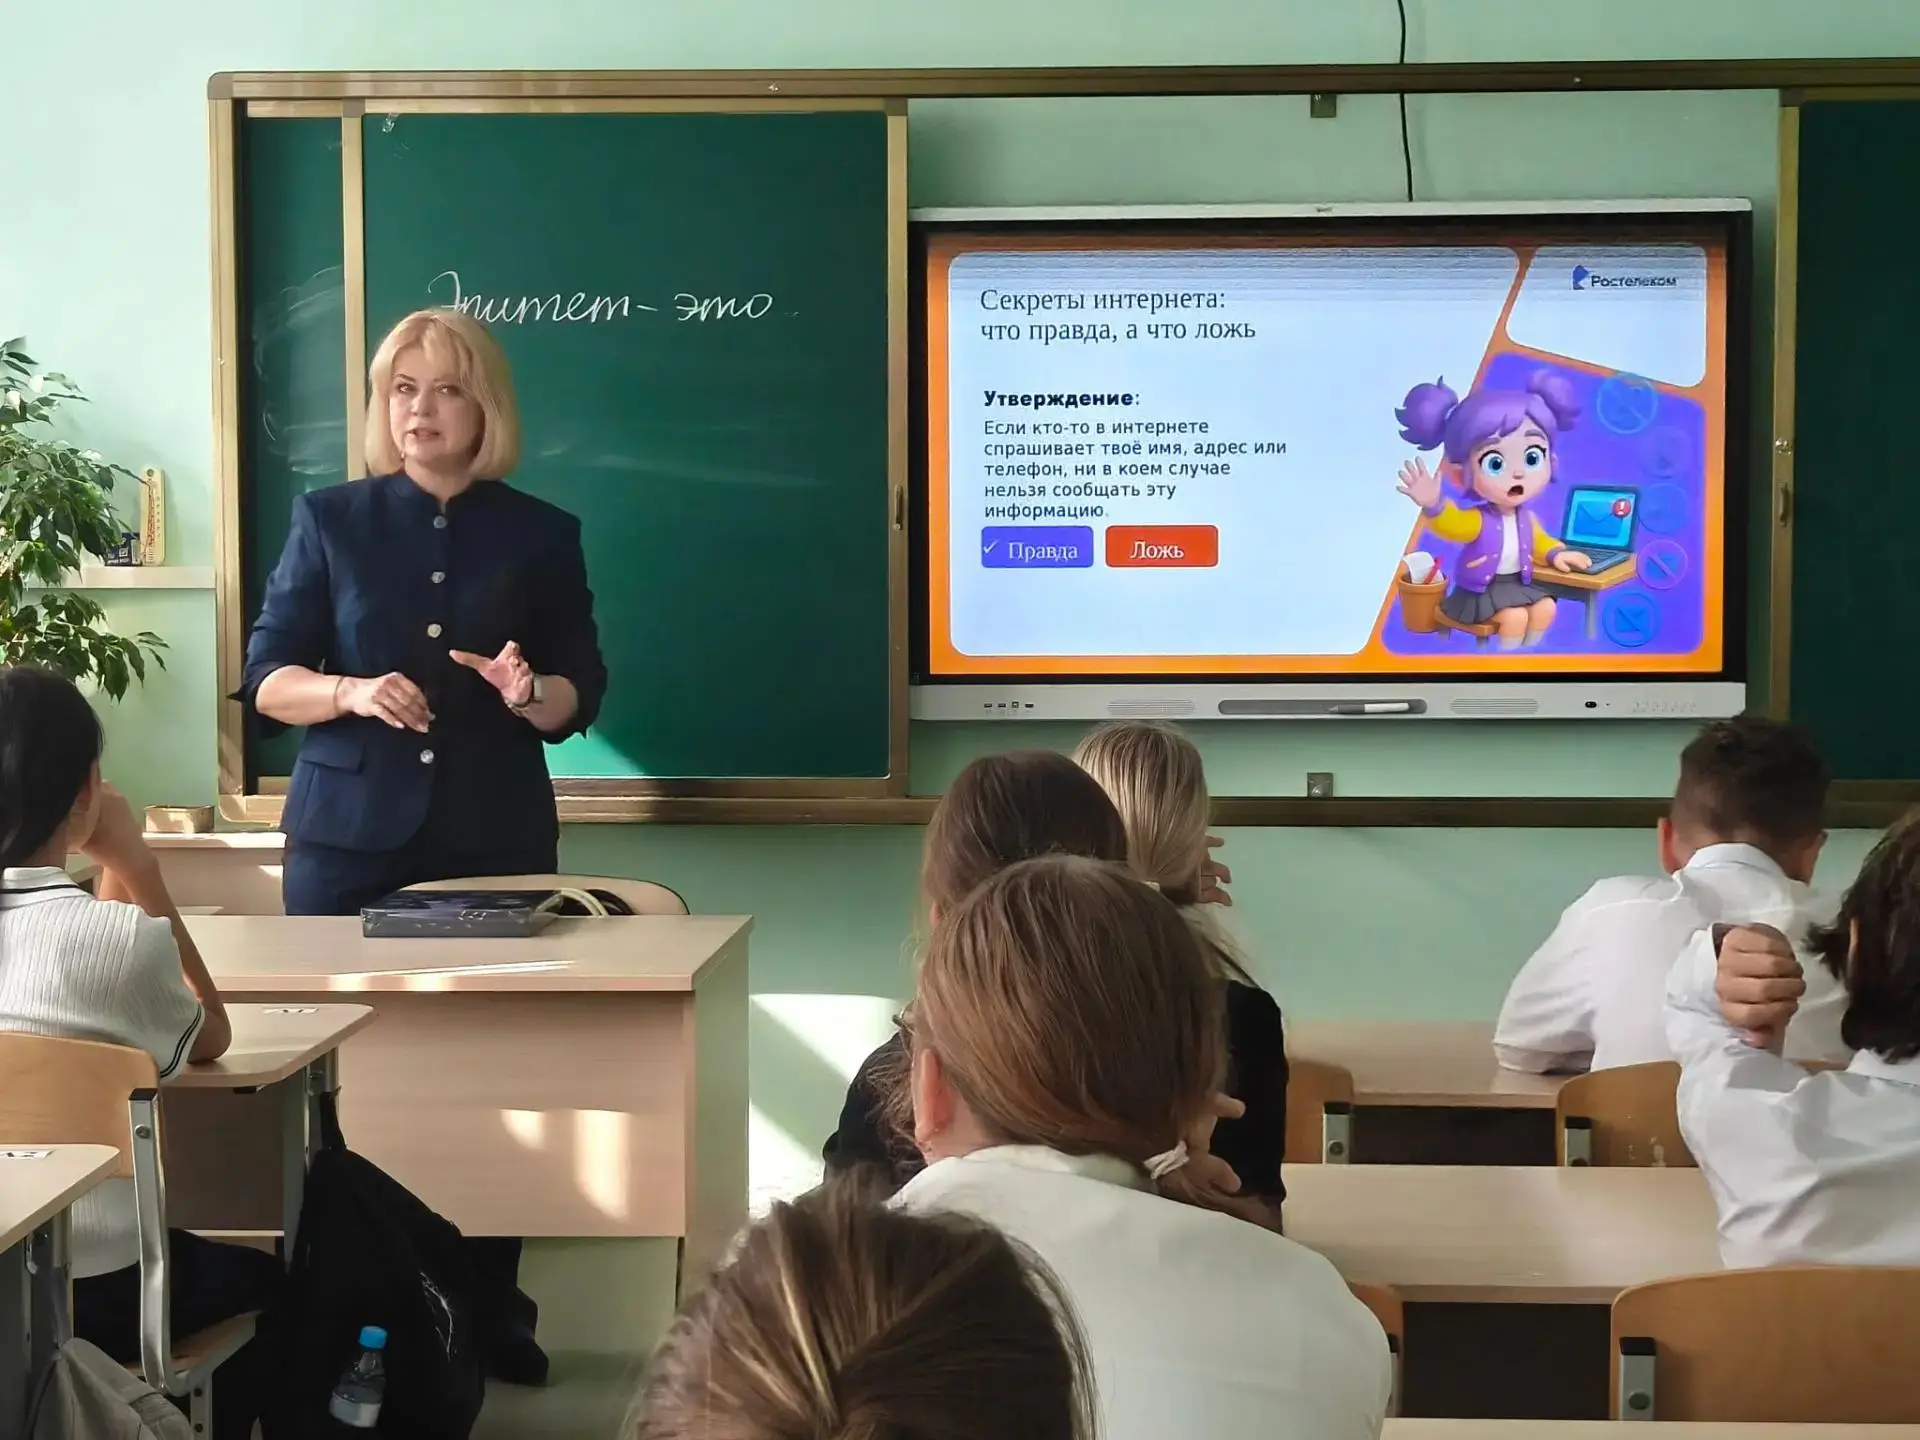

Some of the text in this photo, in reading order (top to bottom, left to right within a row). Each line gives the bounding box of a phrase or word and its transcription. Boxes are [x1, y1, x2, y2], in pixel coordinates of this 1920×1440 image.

[1591, 275, 1677, 288] Ростелеком
[674, 293, 773, 322] это
[980, 289, 1226, 316] Секреты интернета:
[980, 321, 1256, 346] что правда, а что ложь
[983, 390, 1140, 411] Утверждение:
[984, 420, 1209, 439] Если кто-то в интернете
[983, 439, 1287, 460] спрашивает твоё имя, адрес или
[983, 461, 1231, 480] телефон, ни в коем случае
[984, 481, 1177, 501] нельзя сообщать эту
[1008, 541, 1079, 564] Правда
[1129, 540, 1185, 560] Ложь
